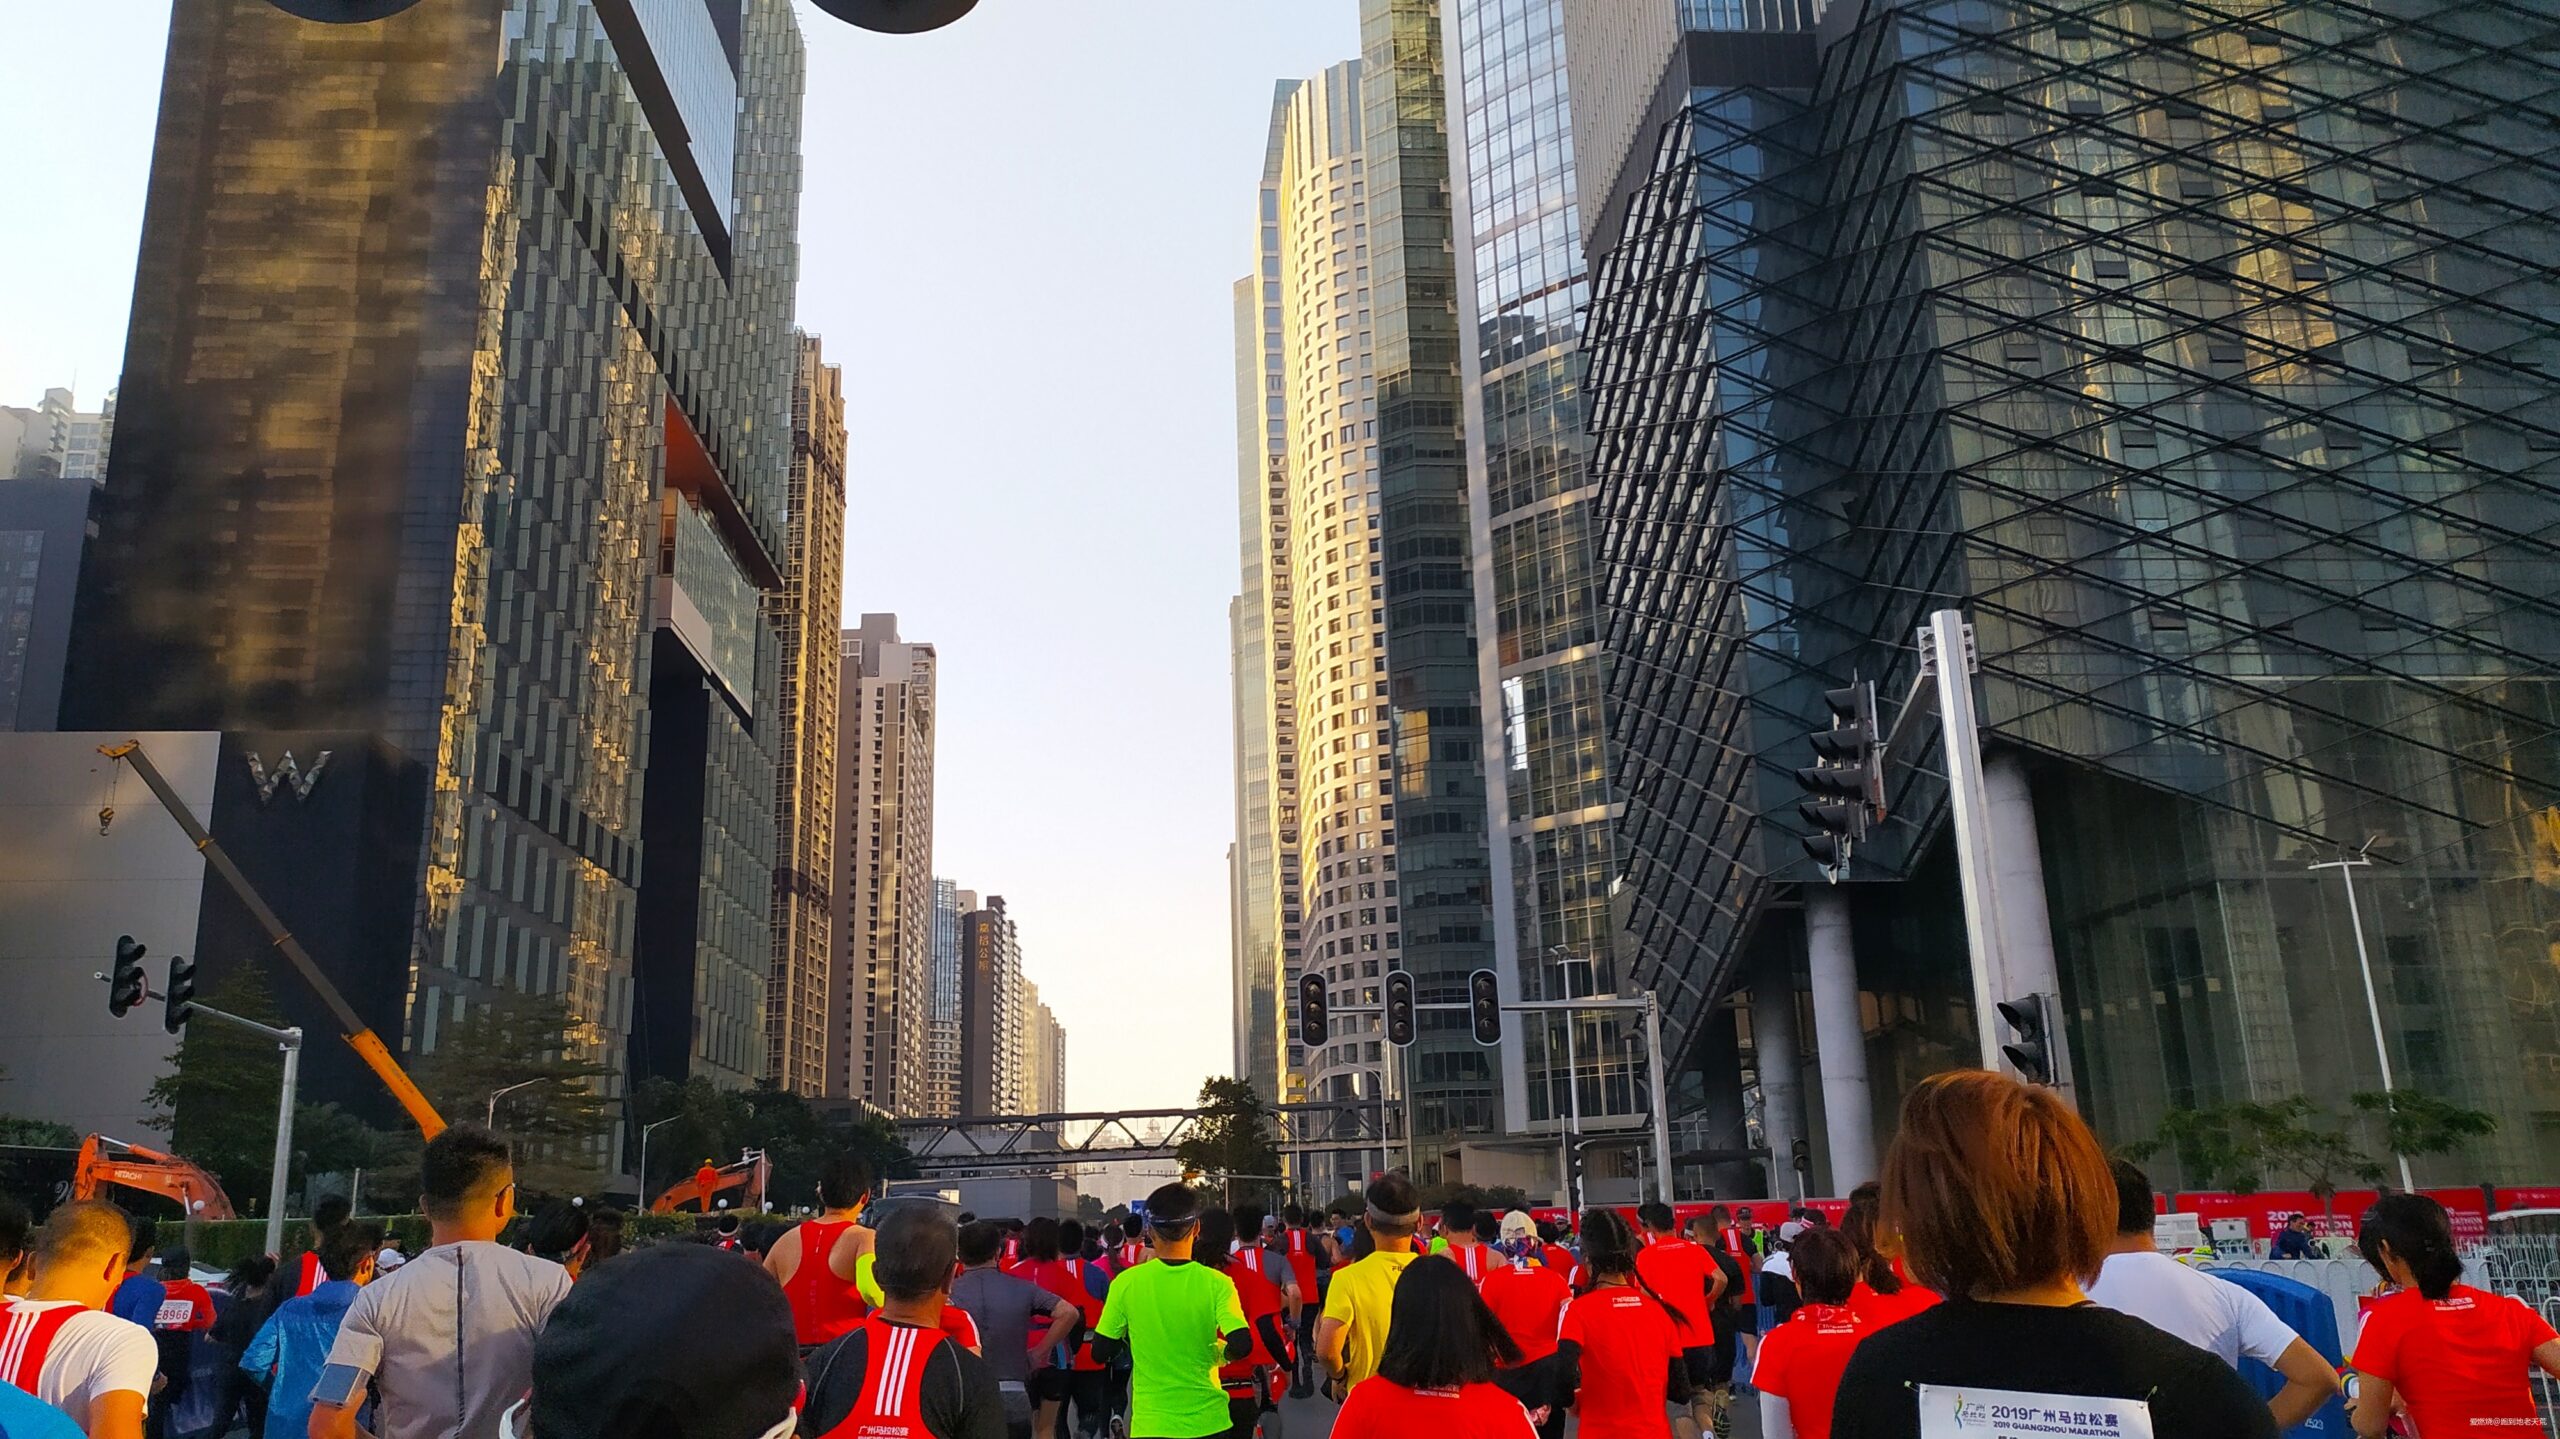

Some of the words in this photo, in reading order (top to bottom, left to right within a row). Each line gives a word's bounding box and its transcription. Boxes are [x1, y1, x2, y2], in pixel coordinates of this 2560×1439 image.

[245, 750, 333, 804] W
[114, 1170, 142, 1181] HITACHI
[1991, 1405, 2118, 1427] 2019广州马拉松赛
[1993, 1421, 2010, 1429] 2019
[2012, 1422, 2067, 1433] GUANGZHOU
[2069, 1427, 2120, 1437] MARATHON
